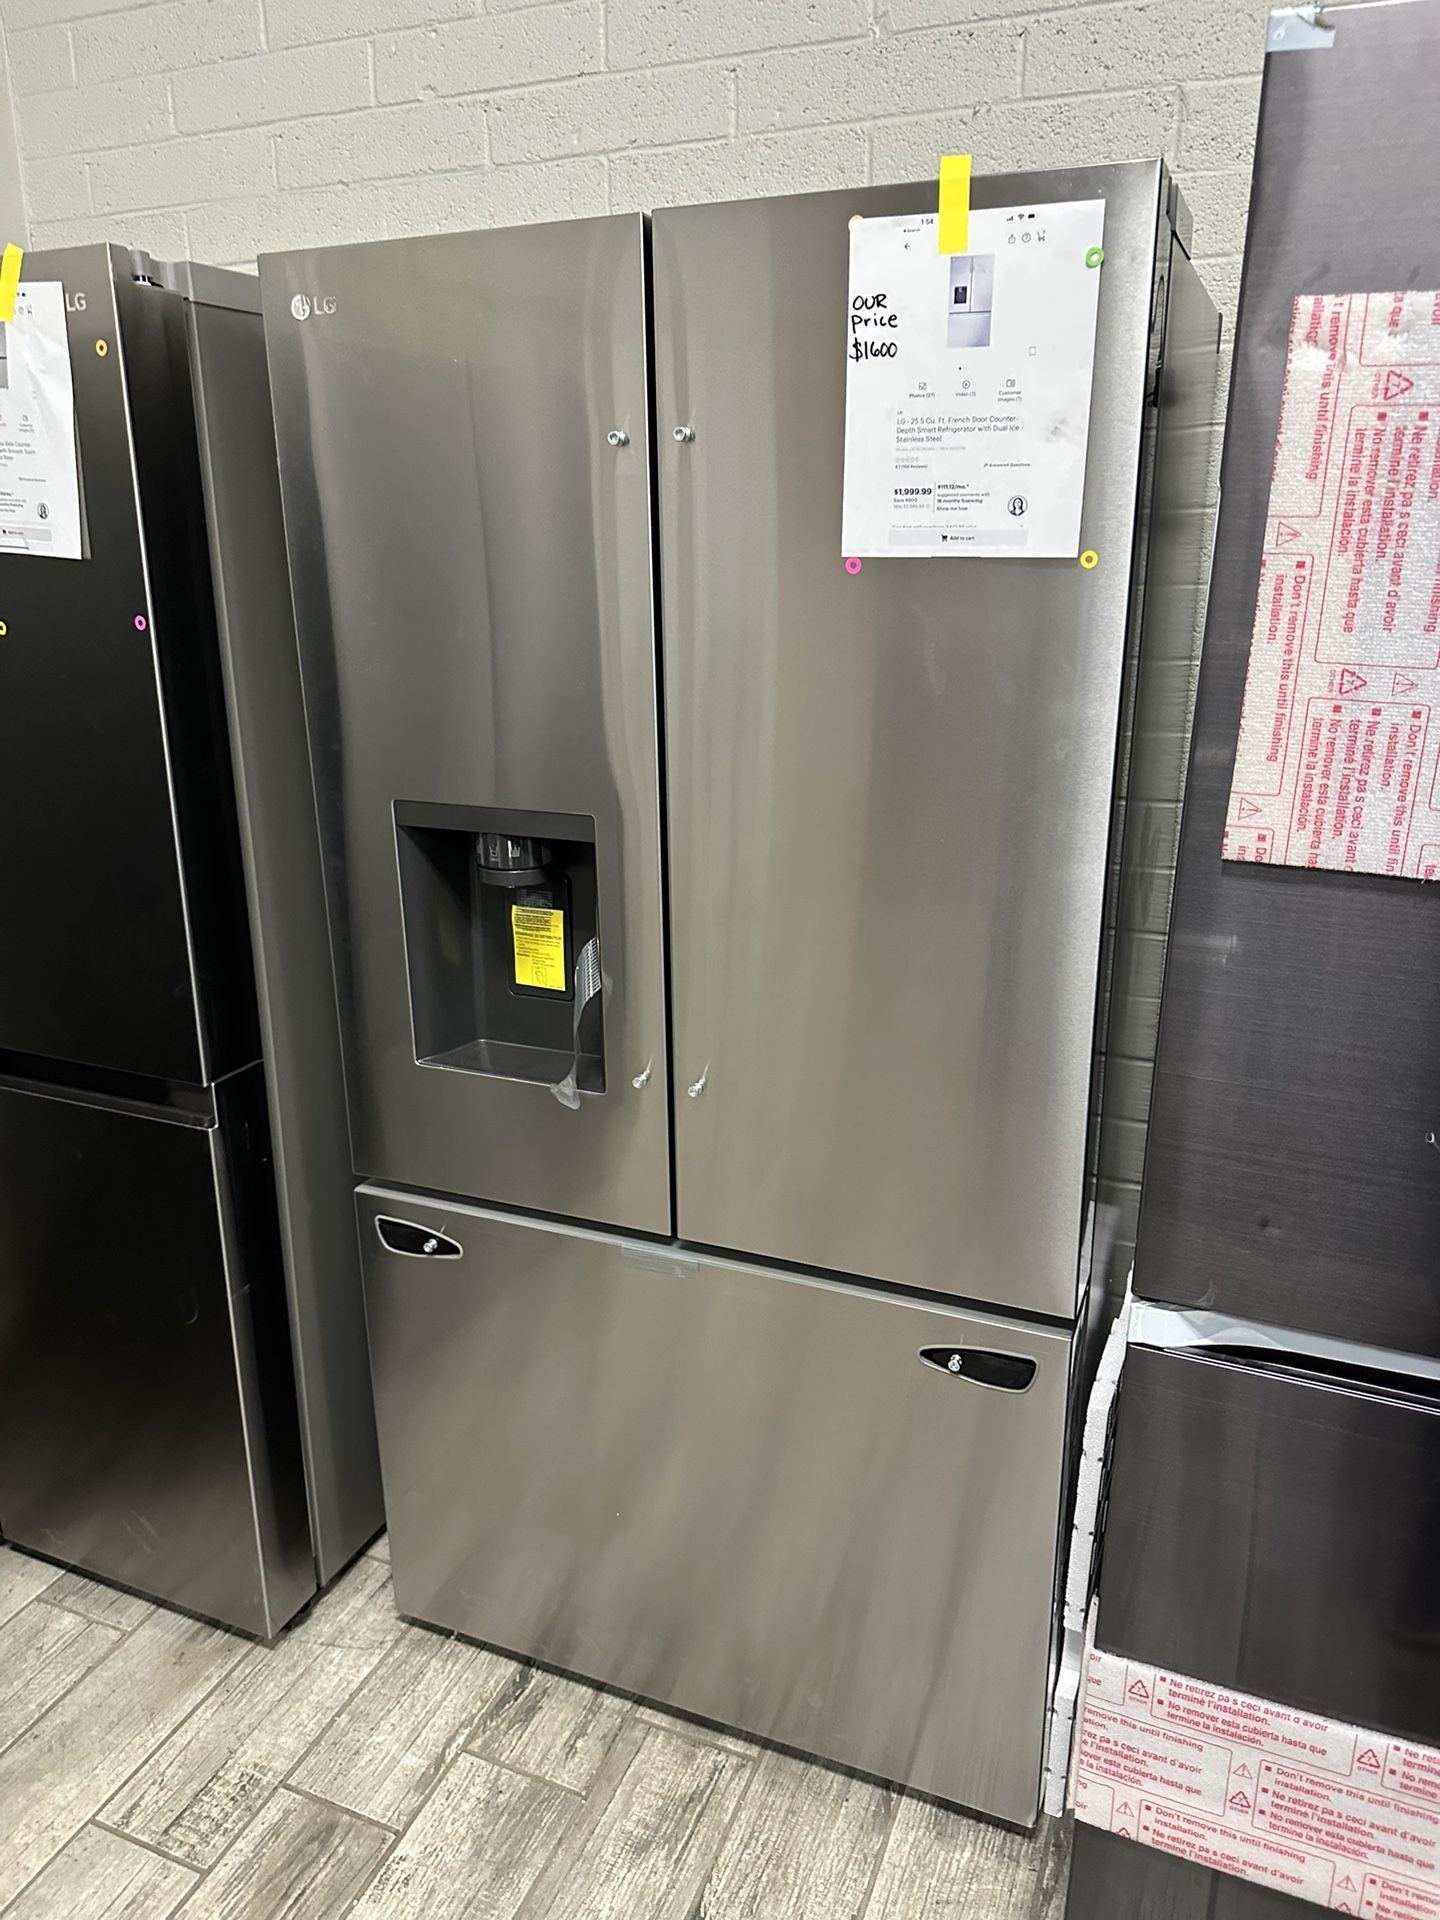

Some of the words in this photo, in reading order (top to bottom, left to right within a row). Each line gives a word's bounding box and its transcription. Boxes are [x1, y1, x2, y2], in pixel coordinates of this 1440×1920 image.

[64, 292, 86, 312] LG
[312, 296, 336, 314] LG
[852, 294, 887, 310] OUR
[849, 338, 898, 362] $1600
[1328, 311, 1341, 361] remove
[896, 427, 916, 435] Depth
[917, 426, 936, 434] Smart
[937, 426, 976, 434] Refrigerator
[993, 424, 1008, 432] Dual
[1372, 428, 1387, 445] No
[1411, 426, 1427, 445] Ne
[1305, 424, 1328, 481] finishing
[1349, 428, 1368, 474] termine
[1348, 476, 1362, 487] la
[1364, 447, 1380, 497] remover
[1404, 447, 1421, 488] retirez
[894, 488, 932, 496] $1,999.99
[1400, 492, 1413, 508] pa
[1360, 499, 1372, 524] esta
[1400, 511, 1410, 519] s
[1395, 522, 1409, 549] ceci
[1352, 528, 1368, 575] cubierta
[1390, 552, 1404, 587] avant
[1290, 575, 1306, 608] Don't
[1347, 577, 1363, 609] hasta
[1342, 611, 1356, 634] que
[1382, 589, 1401, 633] d'avoir
[1284, 611, 1298, 656] remove
[1280, 658, 1294, 681] this
[1276, 683, 1288, 709] until
[1266, 712, 1287, 763] finishing
[1307, 718, 1324, 759] termine
[1328, 718, 1342, 734] No
[1365, 720, 1381, 737] Ne
[1405, 724, 1422, 756] Don't
[1305, 760, 1318, 770] la
[1320, 737, 1337, 781] remover
[1359, 739, 1375, 776] retirez
[1381, 723, 1402, 790] installation.
[1317, 783, 1329, 805] esta
[1356, 778, 1368, 793] pa
[1397, 759, 1413, 803] remove
[1310, 807, 1326, 850] cubierta
[1350, 806, 1364, 829] ceci
[1393, 805, 1407, 826] this
[1344, 831, 1359, 863] avant
[1389, 830, 1401, 856] until
[1170, 1679, 1183, 1689] Ne
[1185, 1684, 1216, 1699] retirez
[1217, 1694, 1230, 1703] pa
[1241, 1701, 1261, 1712] ceci
[1263, 1708, 1291, 1721] avant
[1293, 1716, 1328, 1732] d'avoir
[1208, 1699, 1270, 1726] l'installation.
[1120, 1718, 1137, 1729] this
[1139, 1726, 1161, 1737] until
[1162, 1732, 1206, 1752] finishing
[1167, 1711, 1201, 1727] termine
[1202, 1721, 1211, 1731] la
[1212, 1724, 1264, 1746] instalación.
[1168, 1700, 1181, 1711] No
[1182, 1707, 1220, 1723] remover
[1221, 1719, 1240, 1730] esta
[1242, 1725, 1280, 1742] cubierta
[1281, 1735, 1307, 1750] hasta
[1309, 1745, 1327, 1756] que
[1086, 1760, 1094, 1769] la
[1090, 1741, 1151, 1767] l'installation.
[1099, 1736, 1111, 1744] pa
[1120, 1743, 1140, 1755] ceci
[1141, 1750, 1168, 1764] avant
[1169, 1759, 1202, 1774] d'avoir
[1103, 1758, 1122, 1769] esta
[1123, 1765, 1158, 1781] cubierta
[1159, 1775, 1184, 1790] hasta
[1185, 1786, 1202, 1796] que
[1274, 1778, 1331, 1802] installation.
[1276, 1767, 1303, 1782] Don't
[1305, 1777, 1344, 1794] remove
[1345, 1789, 1365, 1801] this
[1367, 1797, 1391, 1808] until
[1272, 1790, 1286, 1801] Ne
[1287, 1796, 1319, 1812] retirez
[1321, 1807, 1335, 1817] pa
[1345, 1815, 1367, 1826] ceci
[1368, 1822, 1398, 1836] avant
[1311, 1811, 1374, 1839] l'installation.
[1154, 1817, 1207, 1841] installation.
[1155, 1807, 1182, 1821] Don't
[1182, 1817, 1219, 1833] remove
[1219, 1828, 1240, 1840] this
[1240, 1836, 1261, 1848] until
[1263, 1842, 1306, 1864] finishing
[1269, 1821, 1304, 1839] termine
[1305, 1832, 1314, 1842] la
[1270, 1811, 1284, 1822] No
[1285, 1818, 1323, 1835] remover
[1325, 1830, 1345, 1841] esta
[1346, 1837, 1386, 1854] cubierta
[1152, 1828, 1165, 1839] Ne
[1166, 1835, 1196, 1850] retirez
[1198, 1845, 1210, 1854] pa
[1219, 1853, 1240, 1864] ceci
[1241, 1860, 1268, 1873] avant
[1270, 1869, 1304, 1885] d'avoir
